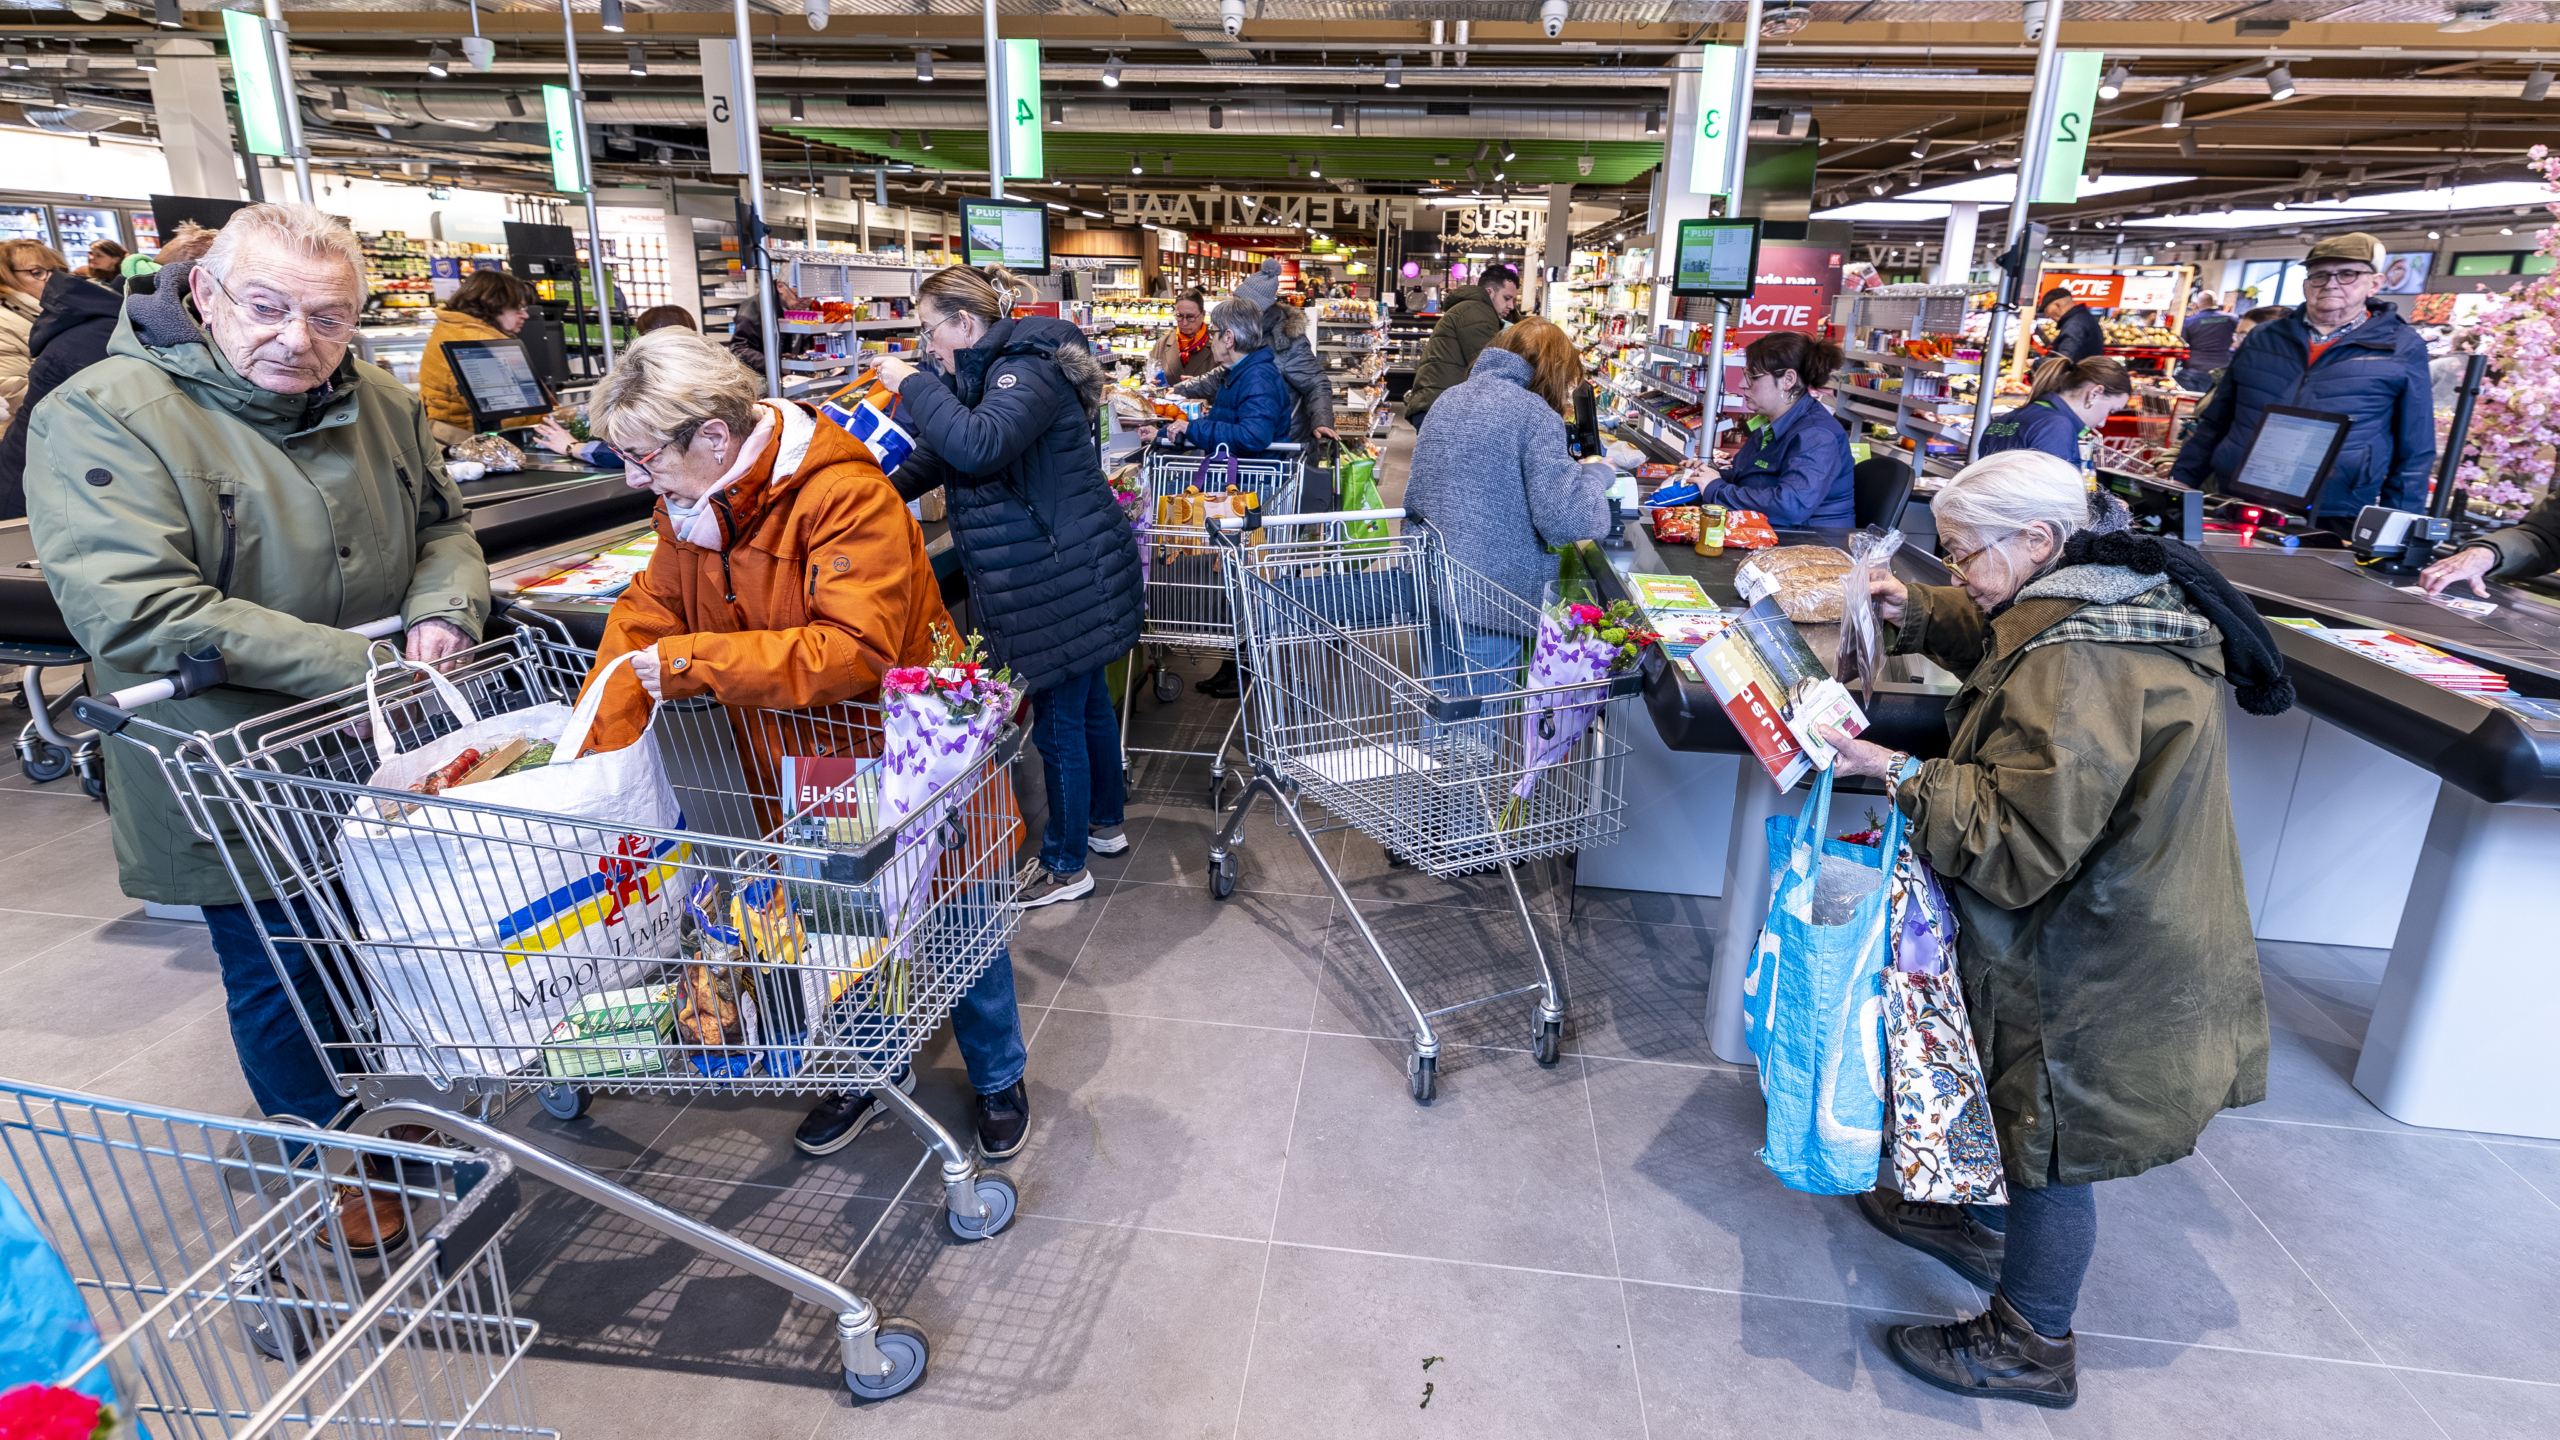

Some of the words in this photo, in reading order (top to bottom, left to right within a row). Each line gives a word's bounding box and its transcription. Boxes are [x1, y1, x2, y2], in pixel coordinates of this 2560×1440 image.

[976, 208, 1002, 218] PLUS
[1691, 229, 1715, 238] PLUS
[1867, 245, 1943, 269] VLEE
[1785, 276, 1817, 286] pan
[2058, 279, 2113, 297] ACTIE
[1743, 304, 1813, 327] ACTIE
[1714, 650, 1793, 753] EIJSDEN
[800, 785, 880, 804] EIJSDE
